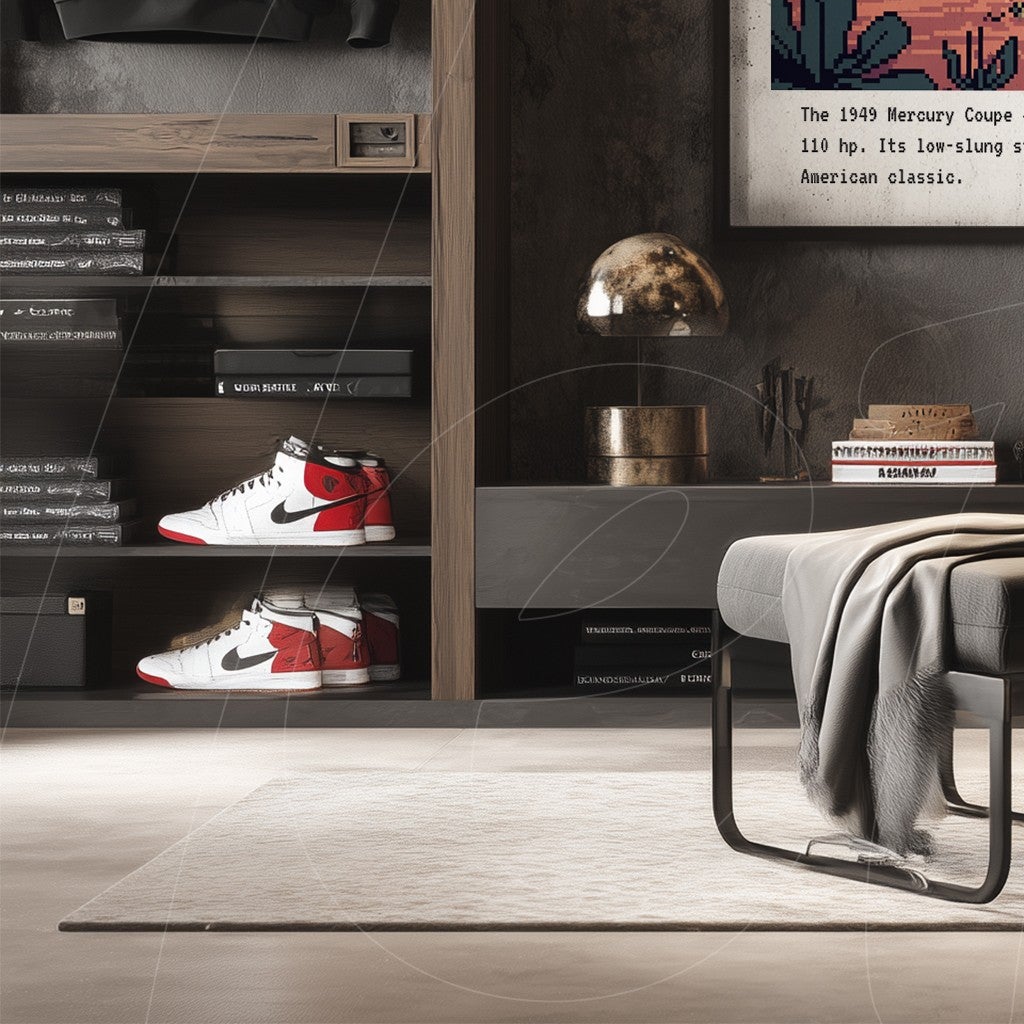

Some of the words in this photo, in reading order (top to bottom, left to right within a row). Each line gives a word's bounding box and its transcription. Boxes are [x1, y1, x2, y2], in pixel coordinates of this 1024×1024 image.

[800, 106, 829, 122] The
[840, 106, 877, 122] 1949
[887, 106, 955, 126] Mercury
[964, 107, 1013, 127] Coupe
[801, 137, 829, 153] 110
[839, 137, 865, 157] hp.
[879, 137, 906, 153] Its
[917, 137, 1003, 157] low-slung
[800, 168, 878, 184] American
[887, 168, 962, 184] classic.
